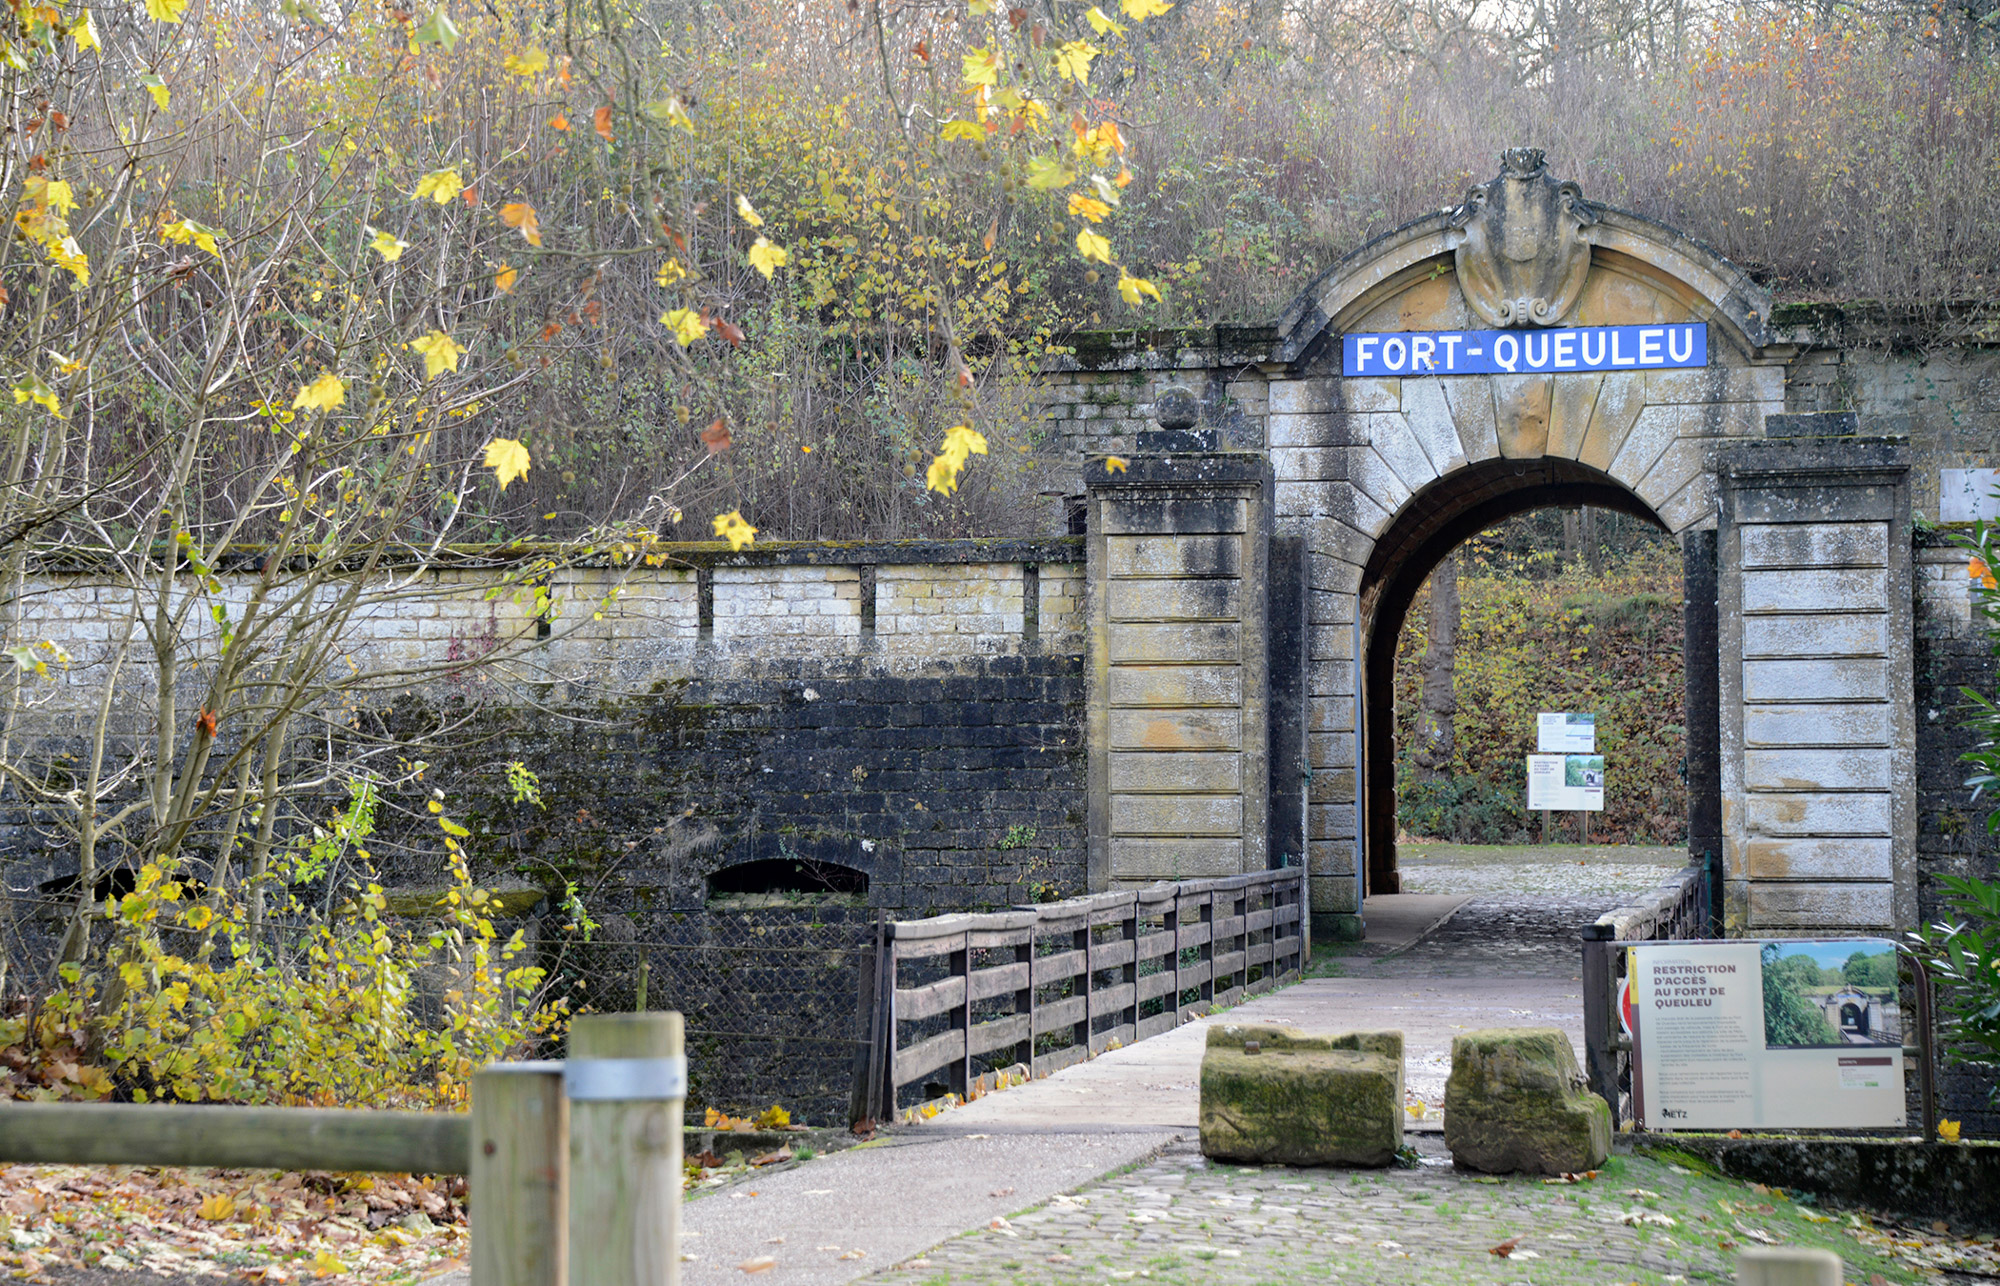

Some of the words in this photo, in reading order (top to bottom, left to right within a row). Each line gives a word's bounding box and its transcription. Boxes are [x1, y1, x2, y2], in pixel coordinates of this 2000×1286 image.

[1653, 965, 1737, 975] RESTRICTION
[1654, 973, 1707, 985] D'ACCÈS
[1654, 987, 1671, 997] AU
[1675, 987, 1707, 996] FORT
[1709, 987, 1726, 996] DE
[1655, 998, 1712, 1010] QUEULEU
